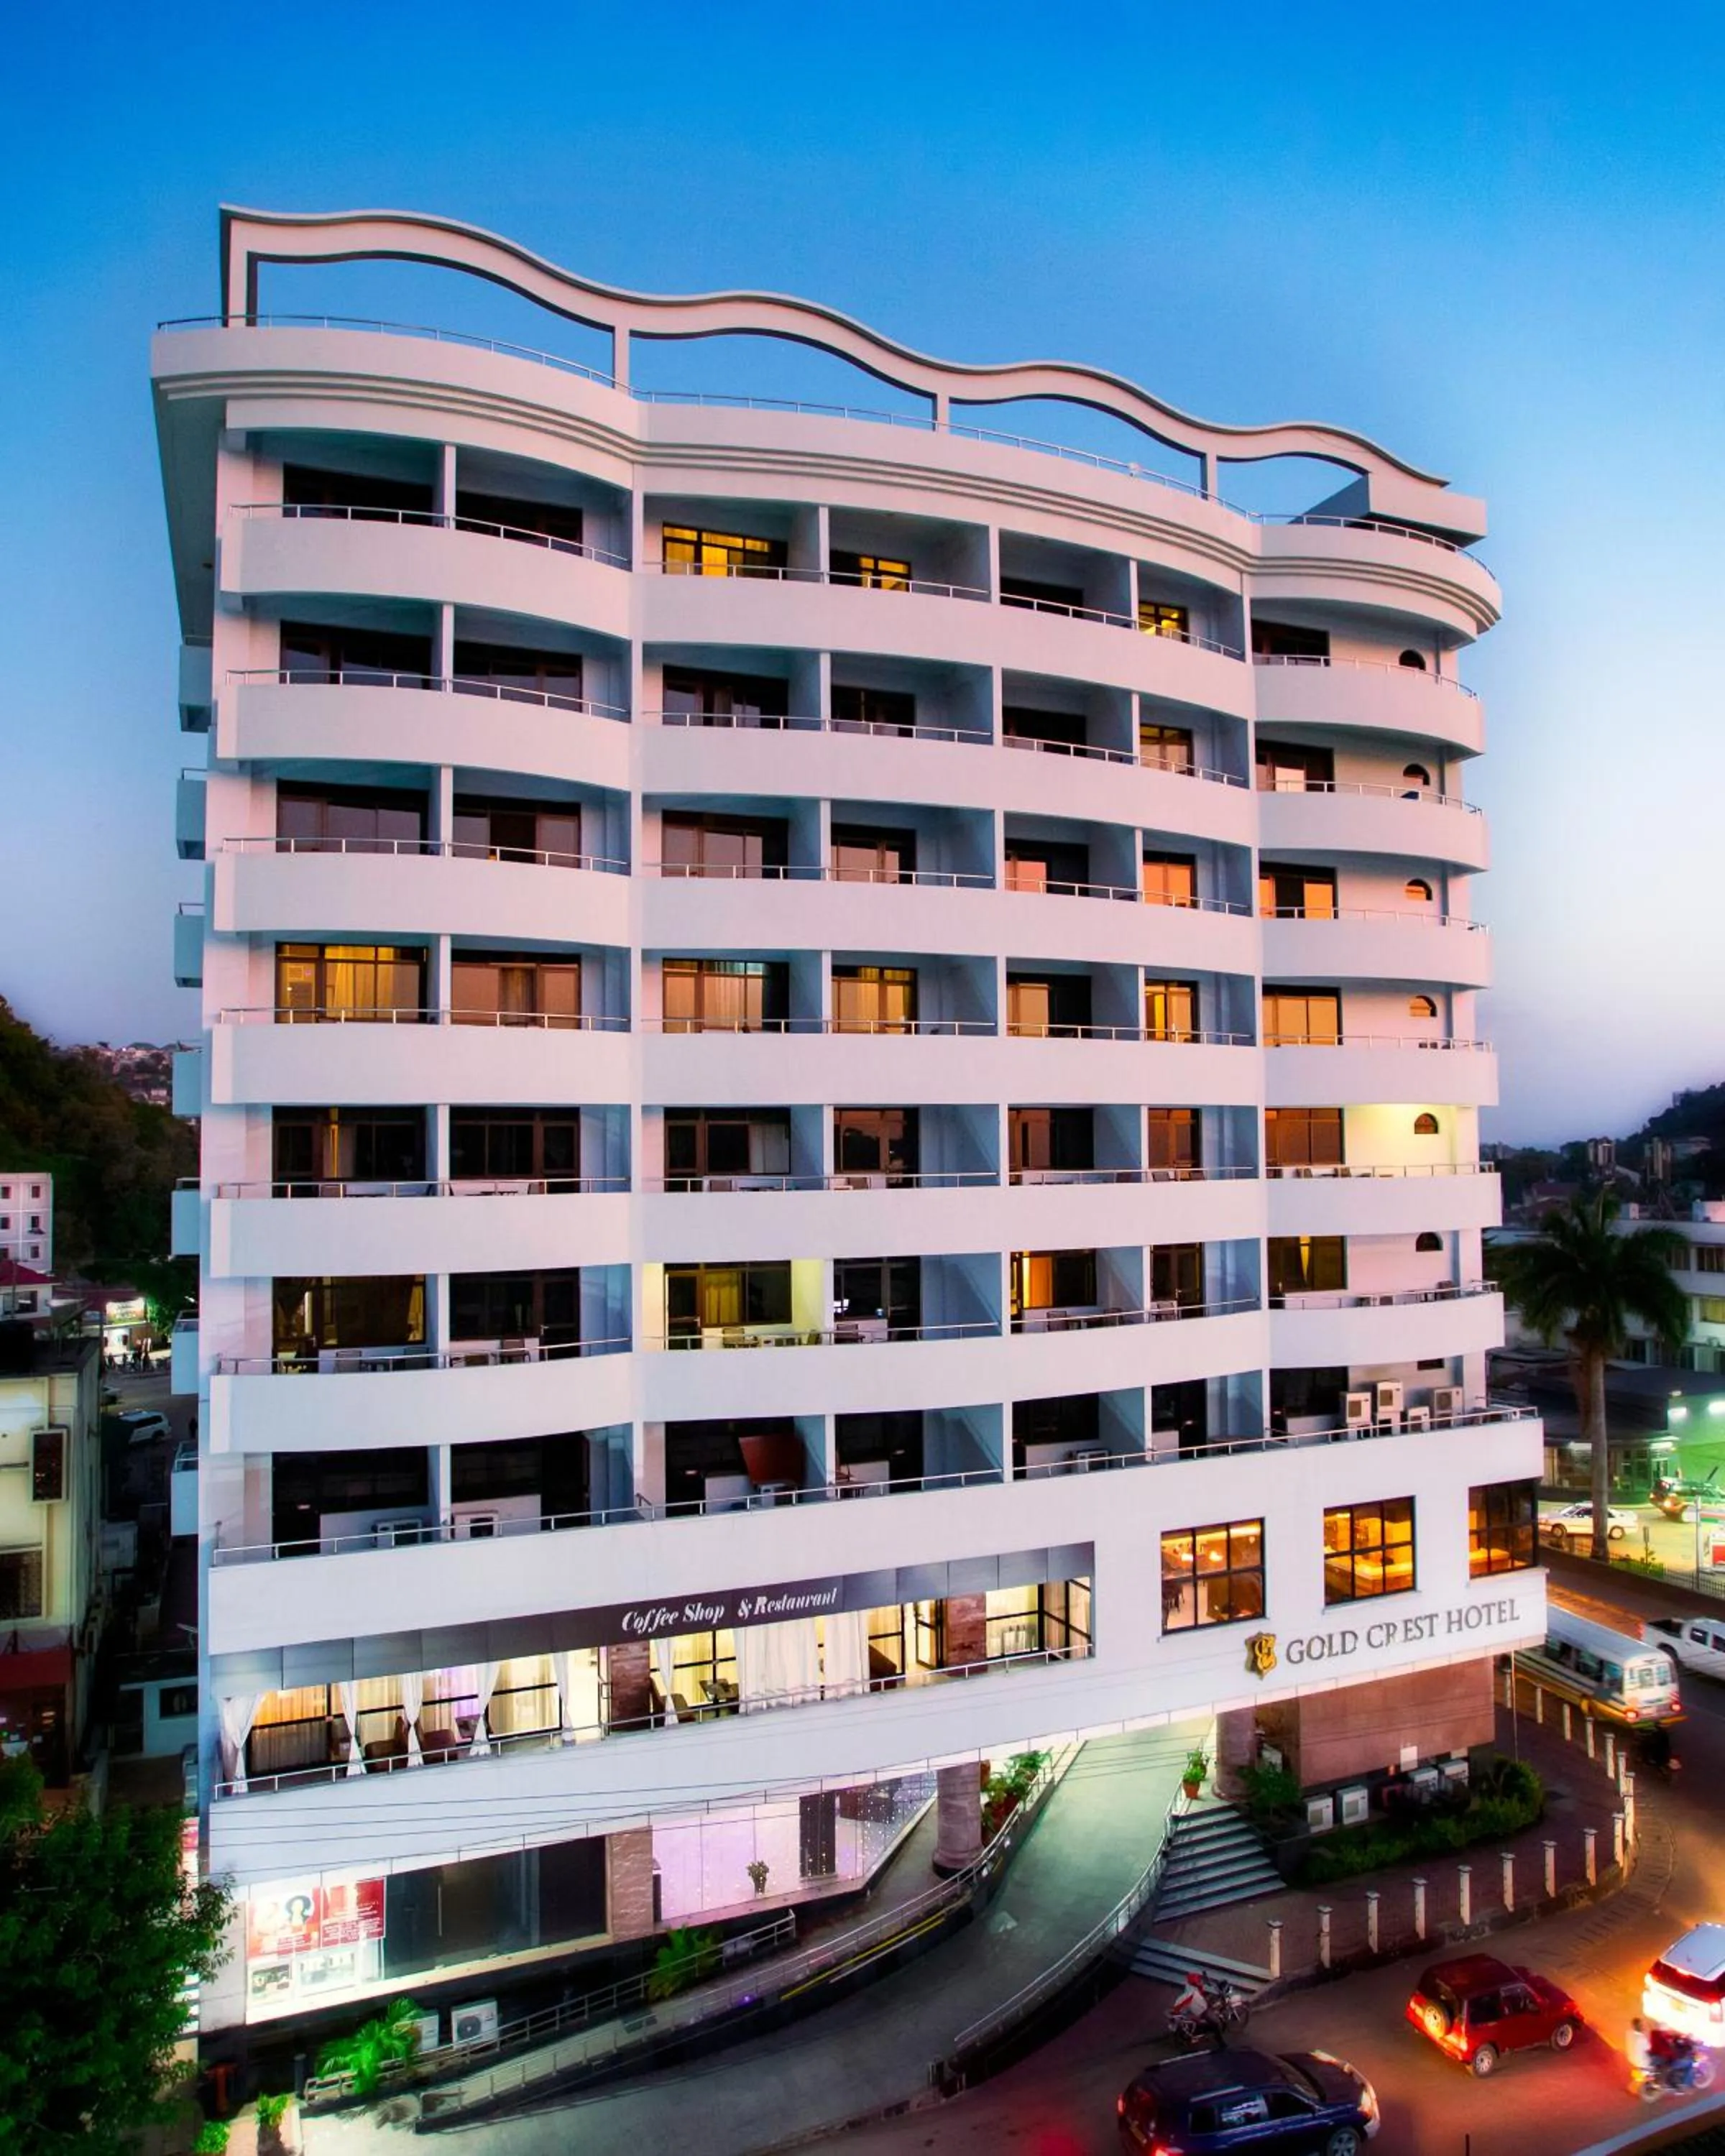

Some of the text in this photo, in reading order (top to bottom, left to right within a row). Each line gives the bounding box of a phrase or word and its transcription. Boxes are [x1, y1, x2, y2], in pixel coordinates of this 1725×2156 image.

[622, 1608, 679, 1634] Coffee
[683, 1602, 724, 1626] Shop
[1286, 1629, 1358, 1664] GOLD
[1366, 1613, 1439, 1649] CREST
[1445, 1598, 1520, 1634] HOTEL
